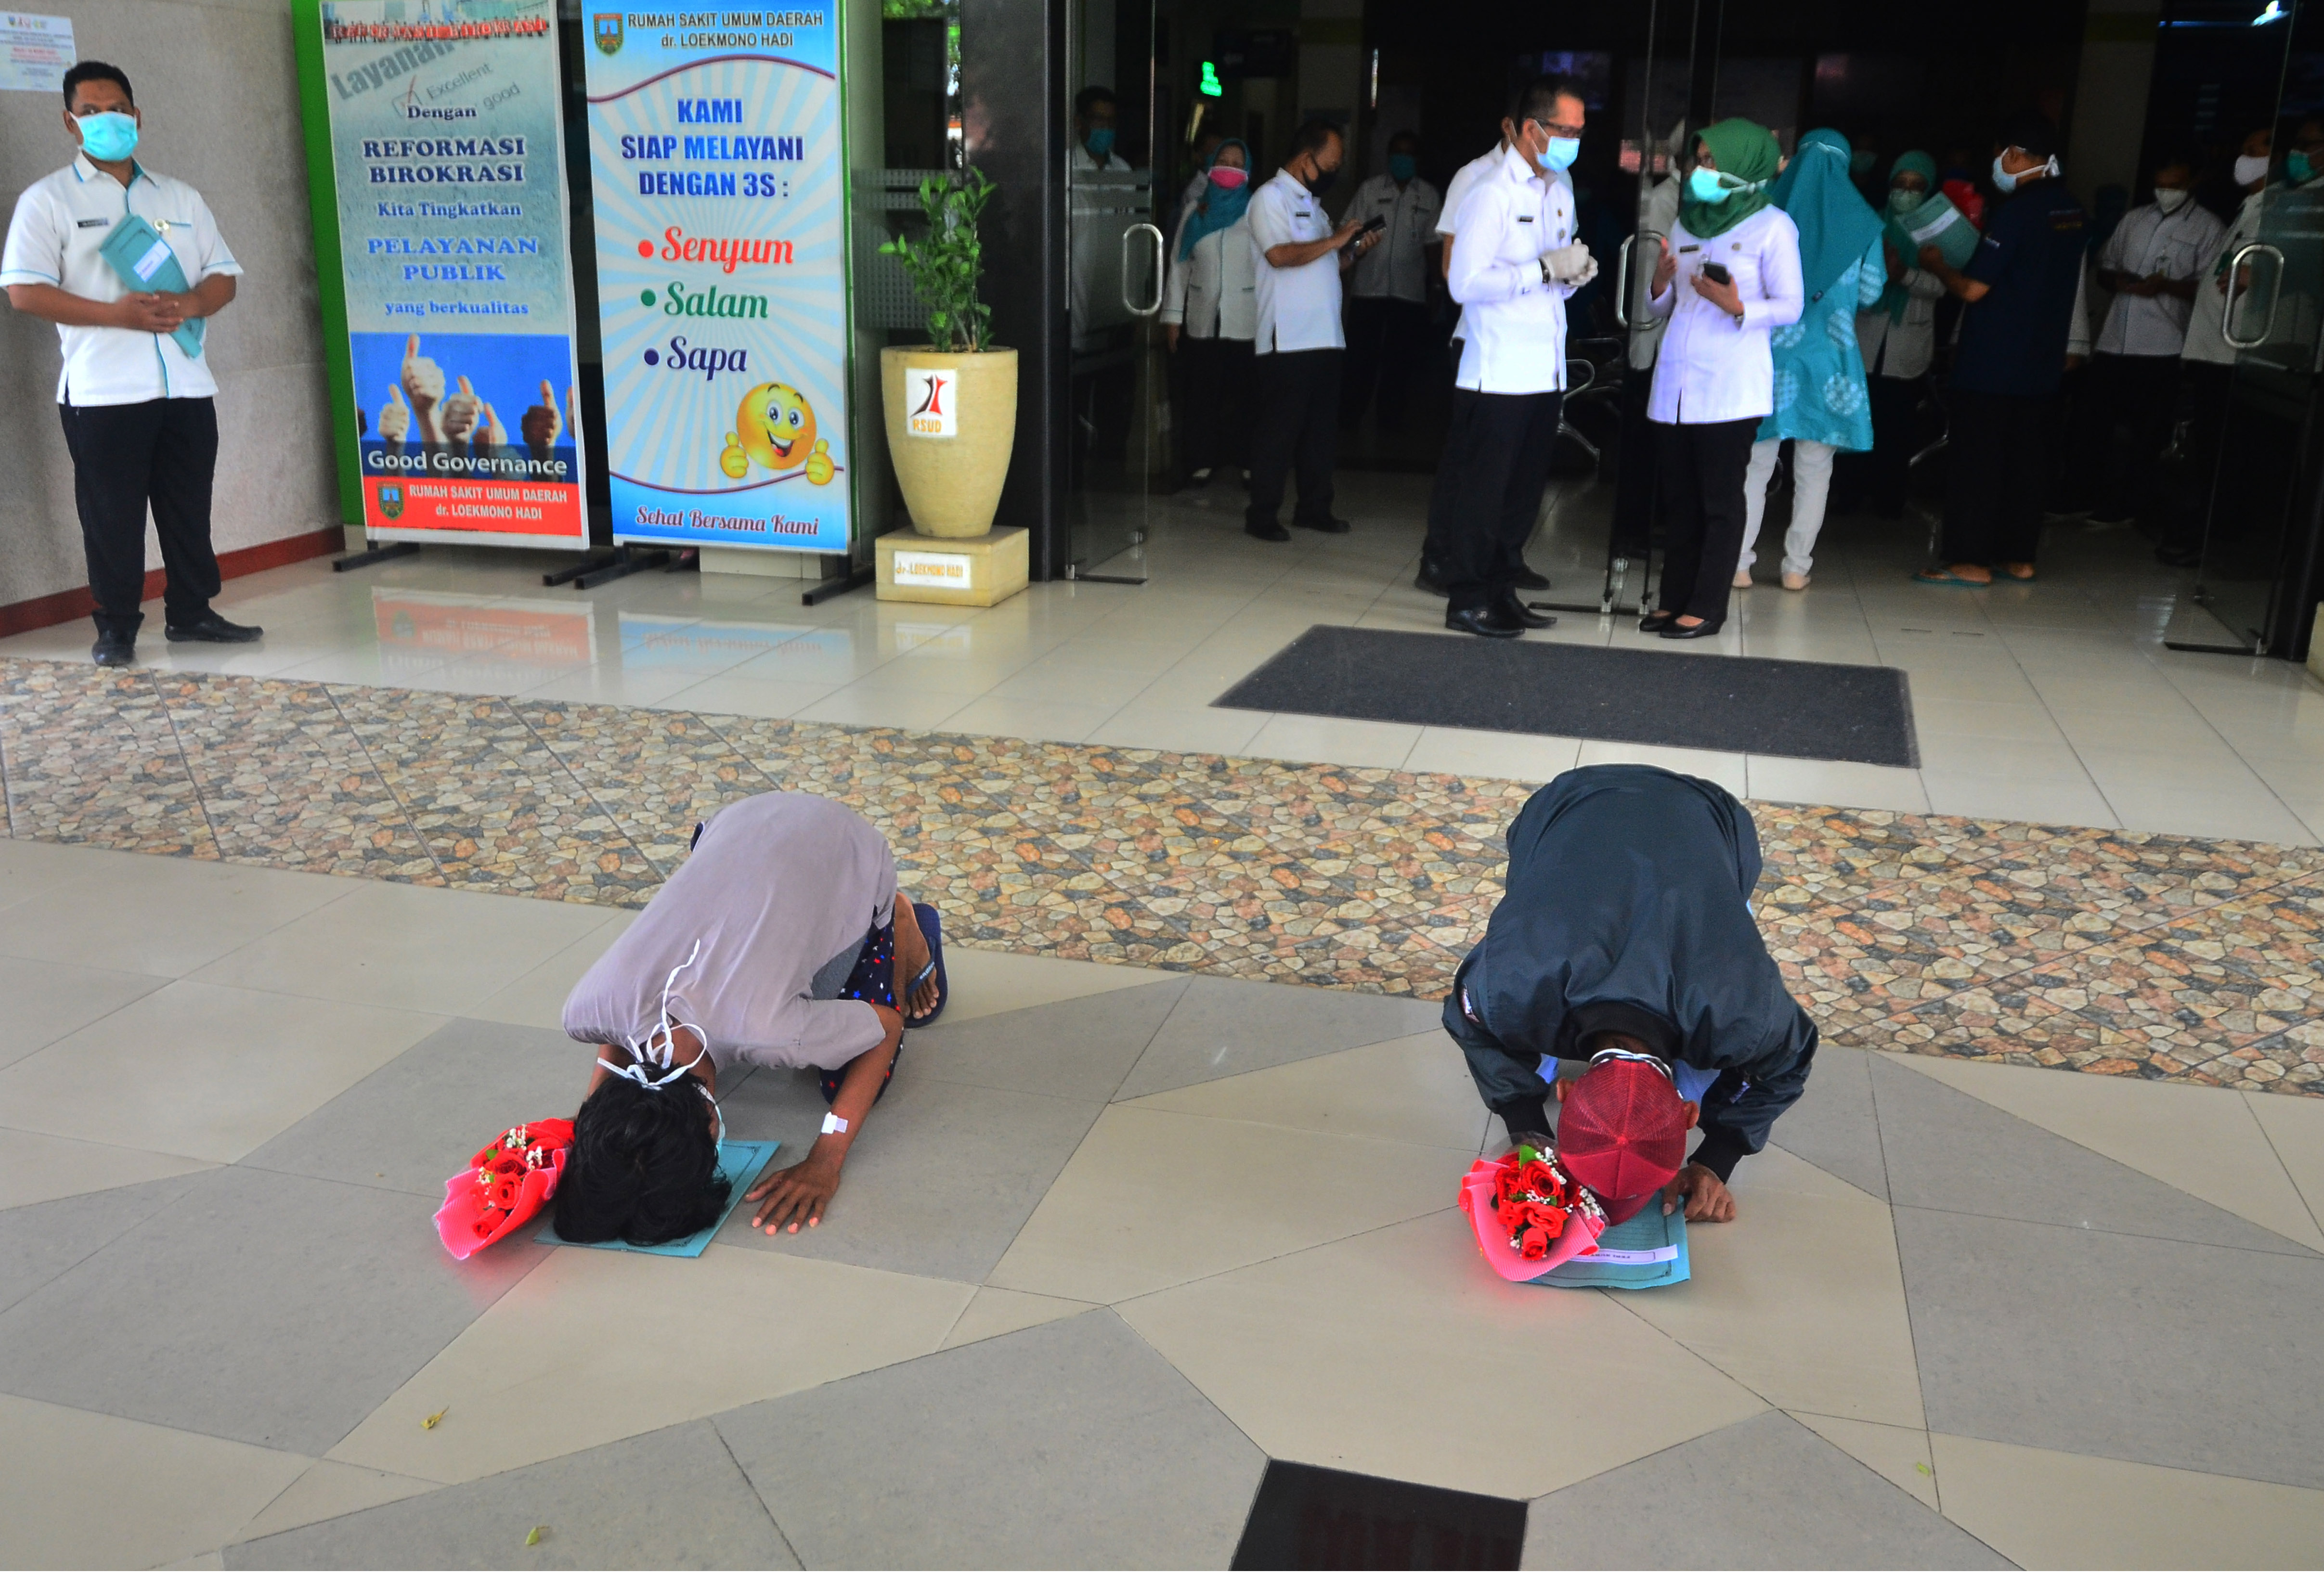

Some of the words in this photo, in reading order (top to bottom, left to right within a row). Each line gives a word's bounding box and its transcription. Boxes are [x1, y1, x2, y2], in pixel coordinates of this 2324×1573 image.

[628, 13, 675, 27] RUMAH
[679, 13, 717, 27] SAKIT
[722, 13, 762, 26] UMUM
[766, 11, 823, 26] DAERAH
[661, 34, 677, 47] dr.
[681, 33, 757, 47] LOEKMONO
[761, 33, 793, 46] HADI
[427, 62, 493, 100] Excellent
[483, 82, 520, 110] good
[407, 105, 477, 120] Dengan
[677, 98, 743, 123] KAMI
[363, 137, 525, 158] REFORMASI
[621, 134, 677, 159] SIAP
[684, 135, 804, 160] MELAYANI
[369, 165, 524, 183] BIROKRASI
[639, 171, 736, 196] DENGAN
[743, 171, 776, 197] 3S
[377, 202, 415, 216] Kita
[419, 202, 521, 219] Tingkatkan
[367, 238, 538, 254] PELAYANAN
[661, 226, 793, 274] Senyum
[403, 264, 506, 281] PUBLIK
[386, 302, 426, 316] yang
[429, 300, 529, 314] berkualitas
[664, 281, 768, 318] Salam
[667, 335, 747, 381] Sapa
[913, 419, 942, 433] RSUD
[367, 450, 427, 469] Good
[433, 452, 568, 476] Governance
[409, 484, 448, 498] RUMAH
[451, 486, 482, 500] SAKIT
[486, 487, 520, 501] UMUM
[523, 489, 567, 503] DAERAH
[436, 504, 449, 516] dr.
[452, 504, 513, 518] LOEKMONO
[516, 506, 542, 519] HADI
[636, 506, 684, 526] Sehat
[688, 509, 766, 532] Bersama
[771, 515, 819, 535] Kami
